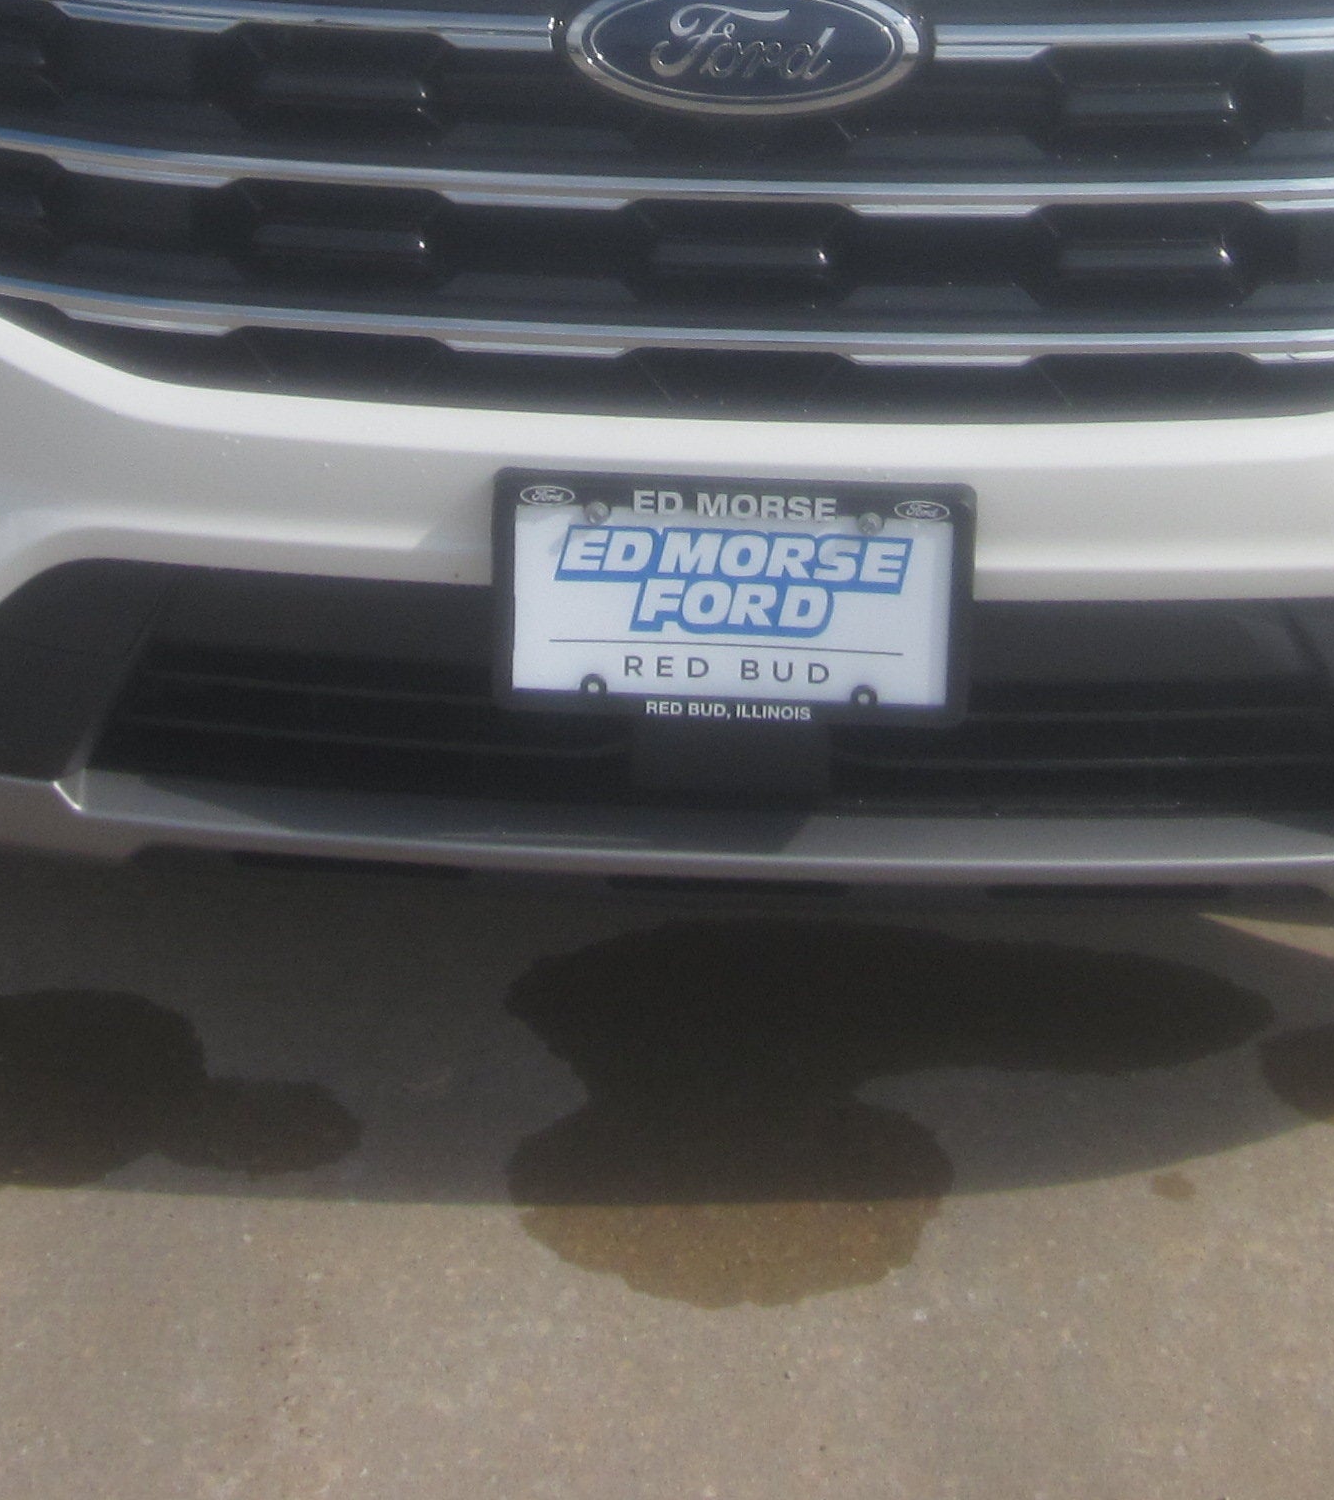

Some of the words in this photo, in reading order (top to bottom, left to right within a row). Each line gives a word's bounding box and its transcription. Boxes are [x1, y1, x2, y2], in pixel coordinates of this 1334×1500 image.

[649, 2, 836, 80] Ford
[531, 489, 565, 501] Ford
[632, 489, 684, 515] ED
[696, 493, 838, 523] MORSE
[906, 503, 939, 518] Ford
[561, 529, 653, 573] ED
[658, 532, 905, 585] MORSE
[636, 579, 830, 631] FORD
[623, 656, 710, 679] RED
[740, 660, 830, 685] BUD
[645, 701, 683, 716] RED
[688, 702, 731, 720] BUD,
[736, 704, 811, 721] ILLINOIS
